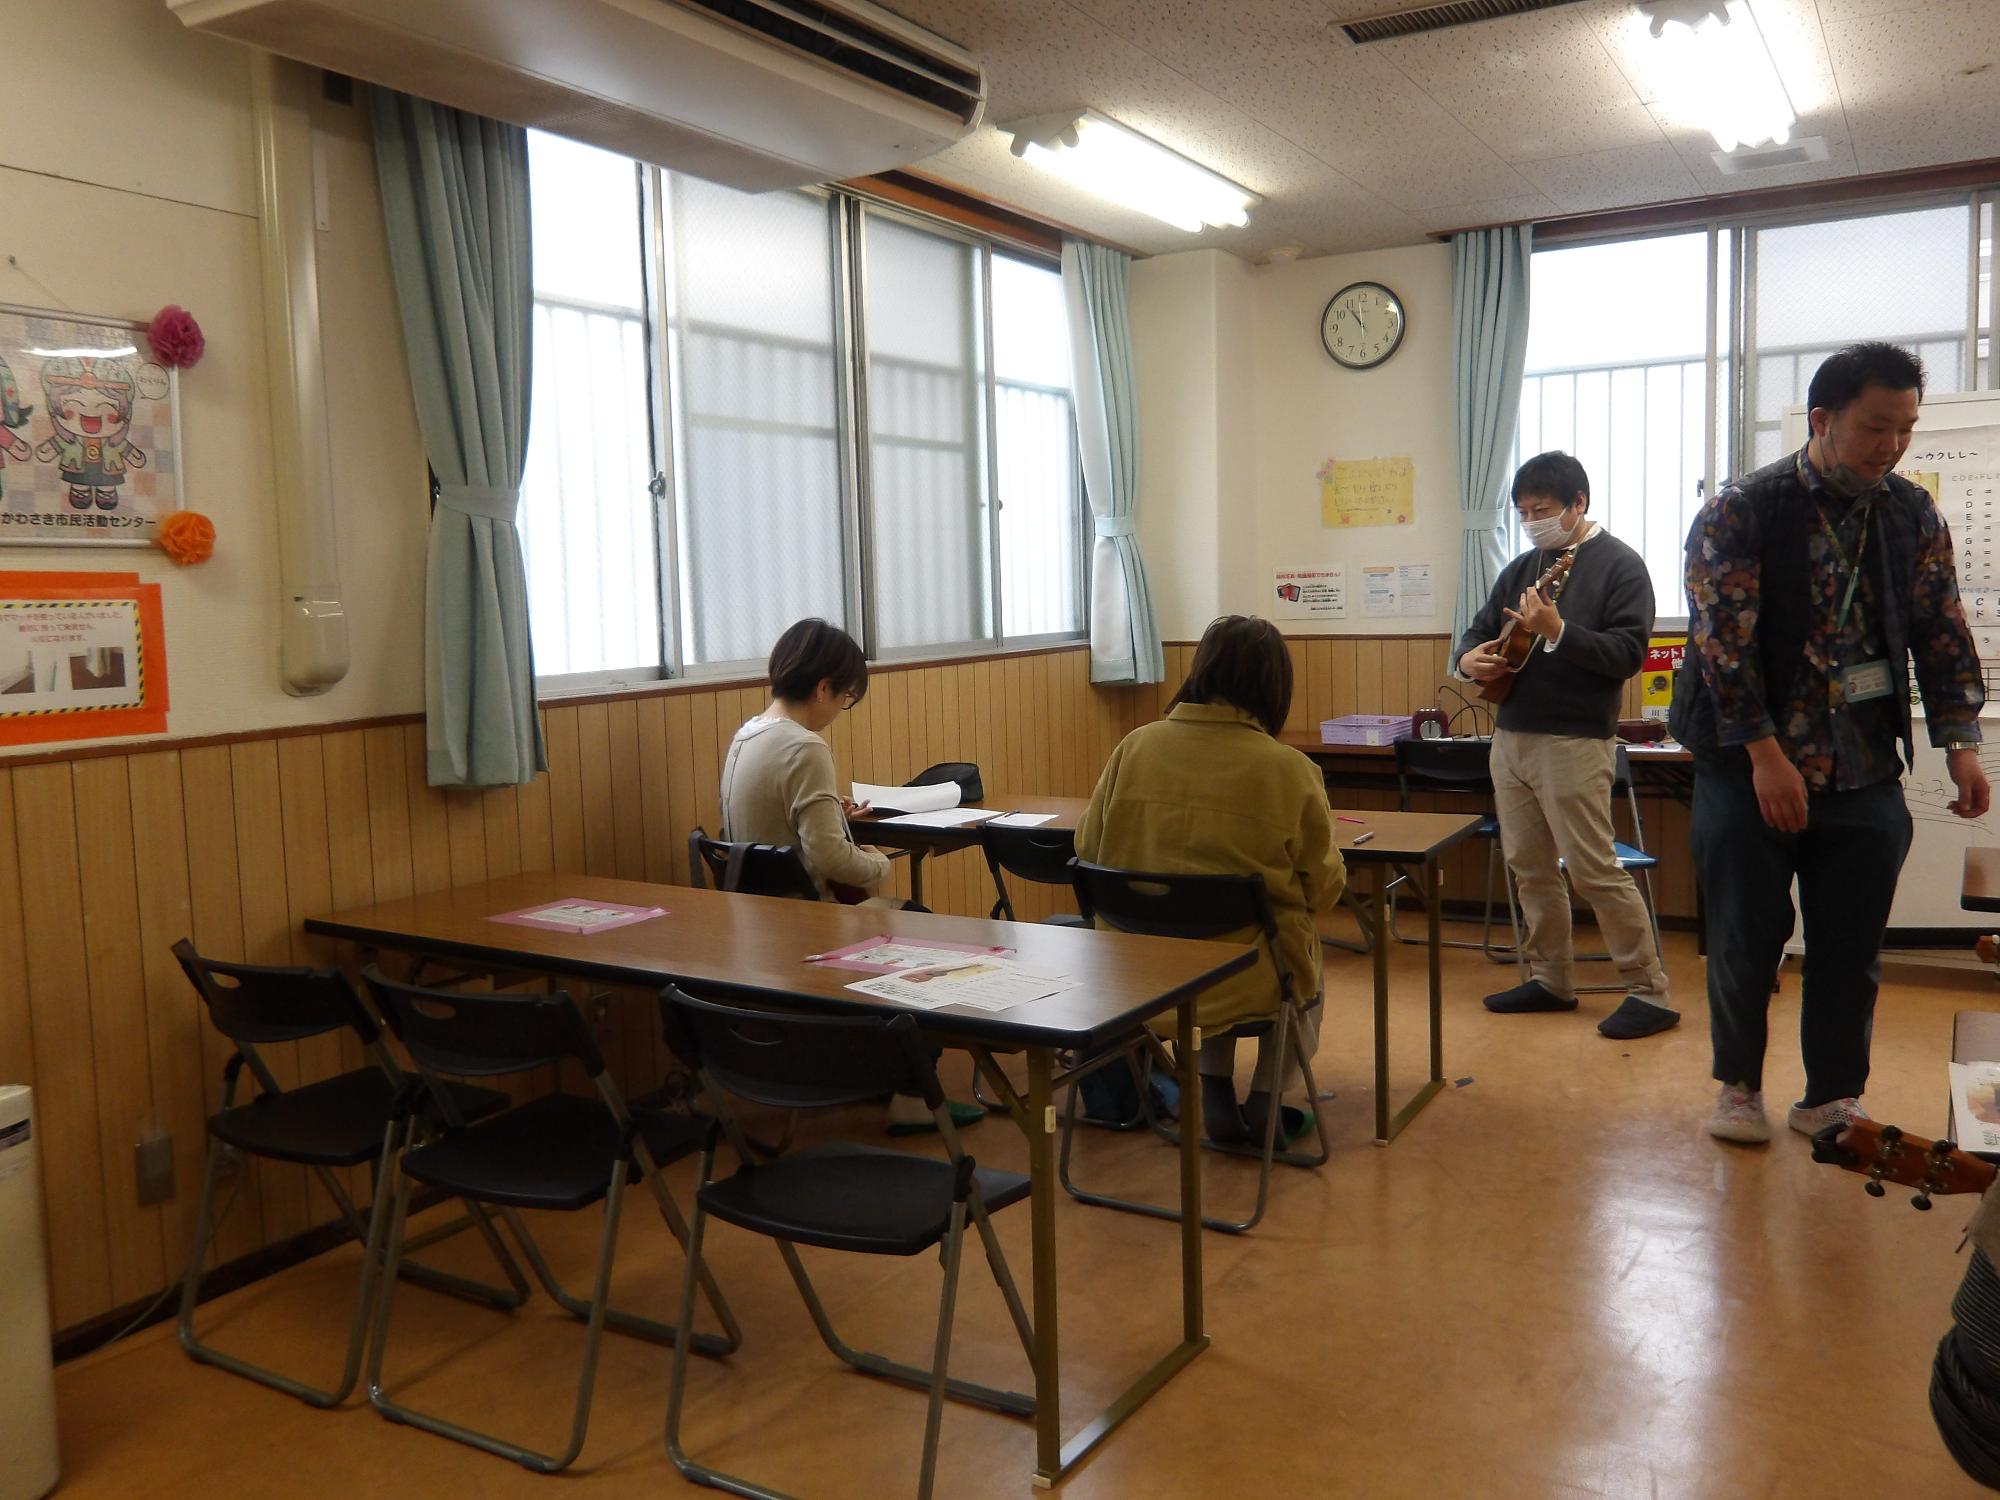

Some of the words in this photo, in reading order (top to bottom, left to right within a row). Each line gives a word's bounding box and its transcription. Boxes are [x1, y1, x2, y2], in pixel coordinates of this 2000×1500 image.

[1966, 488, 1973, 497] C
[1965, 501, 1973, 509] D
[0, 512, 157, 528] かわさき市民活動センター
[1965, 513, 1972, 521] E
[1965, 537, 1973, 545] G
[1965, 561, 1971, 569] B
[1965, 574, 1972, 582] C
[1975, 597, 1984, 606] C
